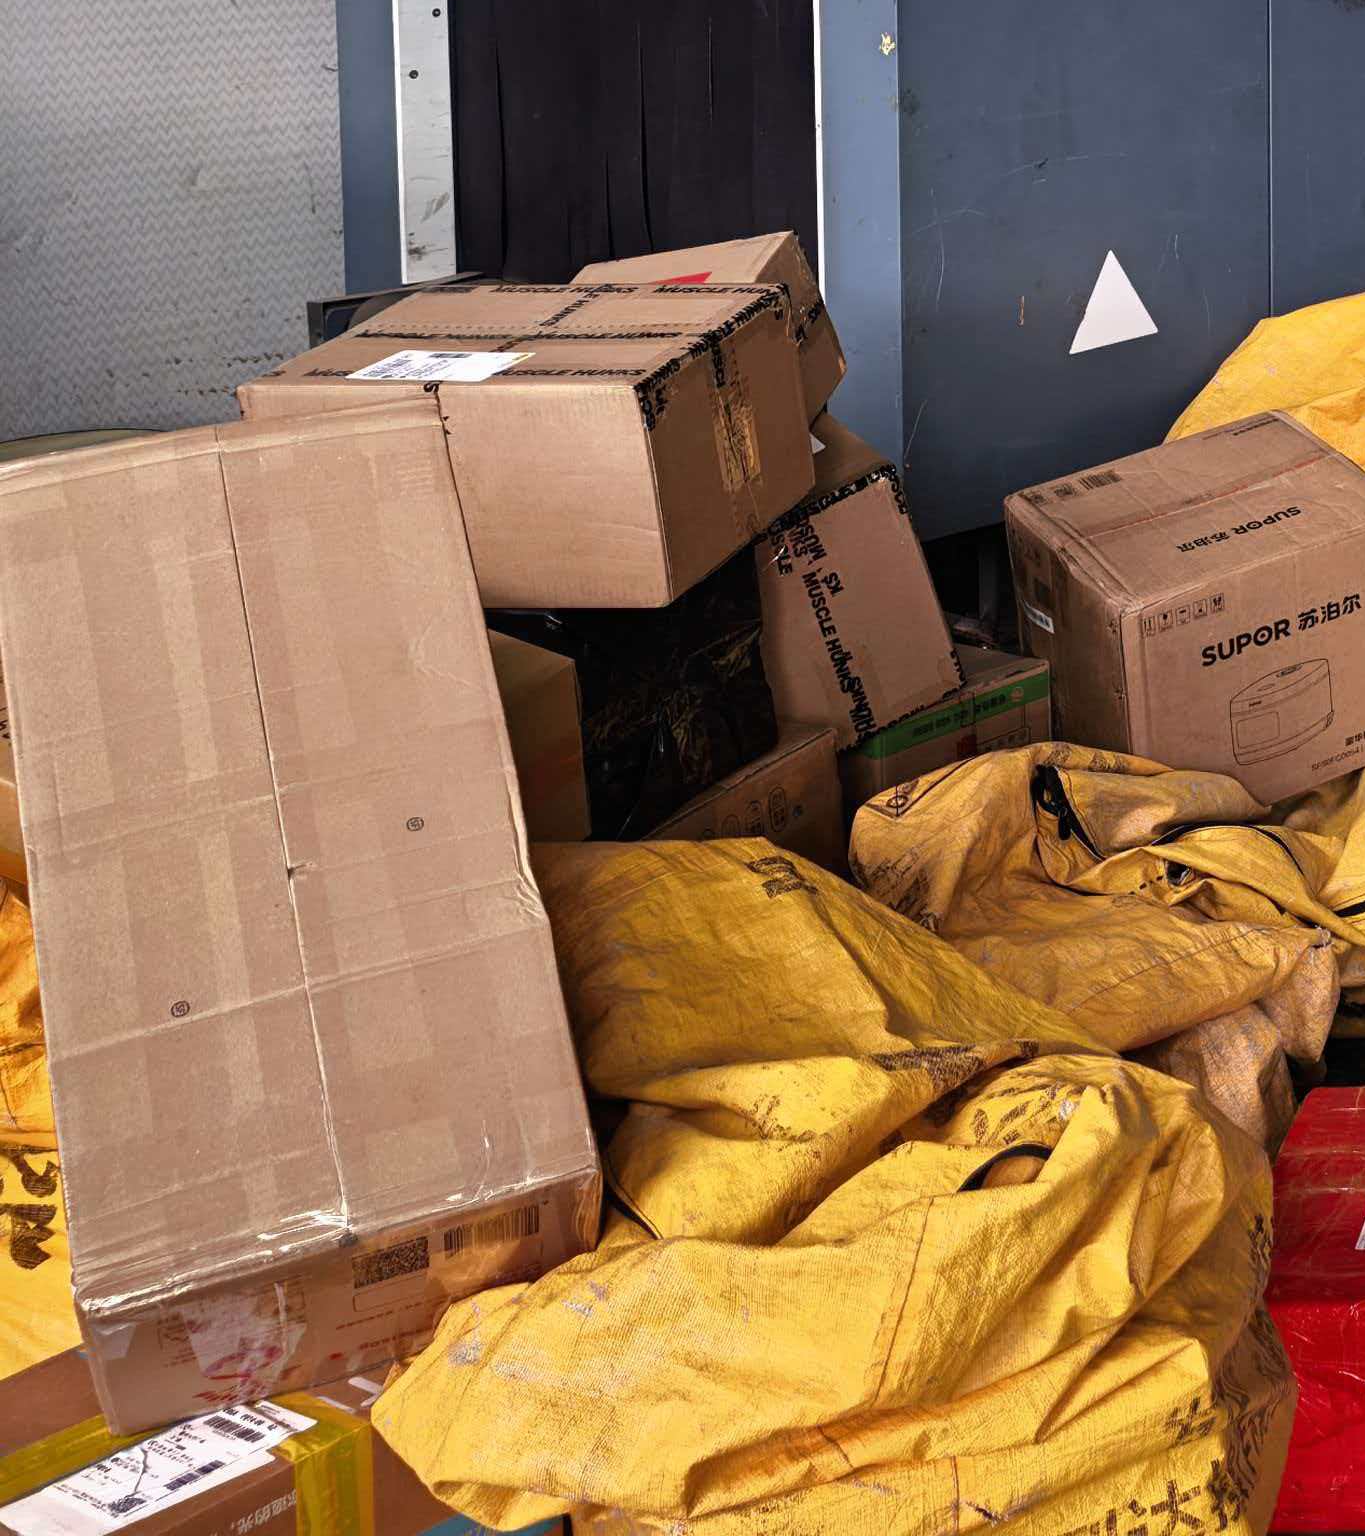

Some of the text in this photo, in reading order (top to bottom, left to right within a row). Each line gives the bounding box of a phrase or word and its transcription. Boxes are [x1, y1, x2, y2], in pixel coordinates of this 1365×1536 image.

[1232, 506, 1302, 535] SUPOR
[802, 572, 837, 638] MUSCLE
[1201, 592, 1362, 667] SUPOR 苏泊尔
